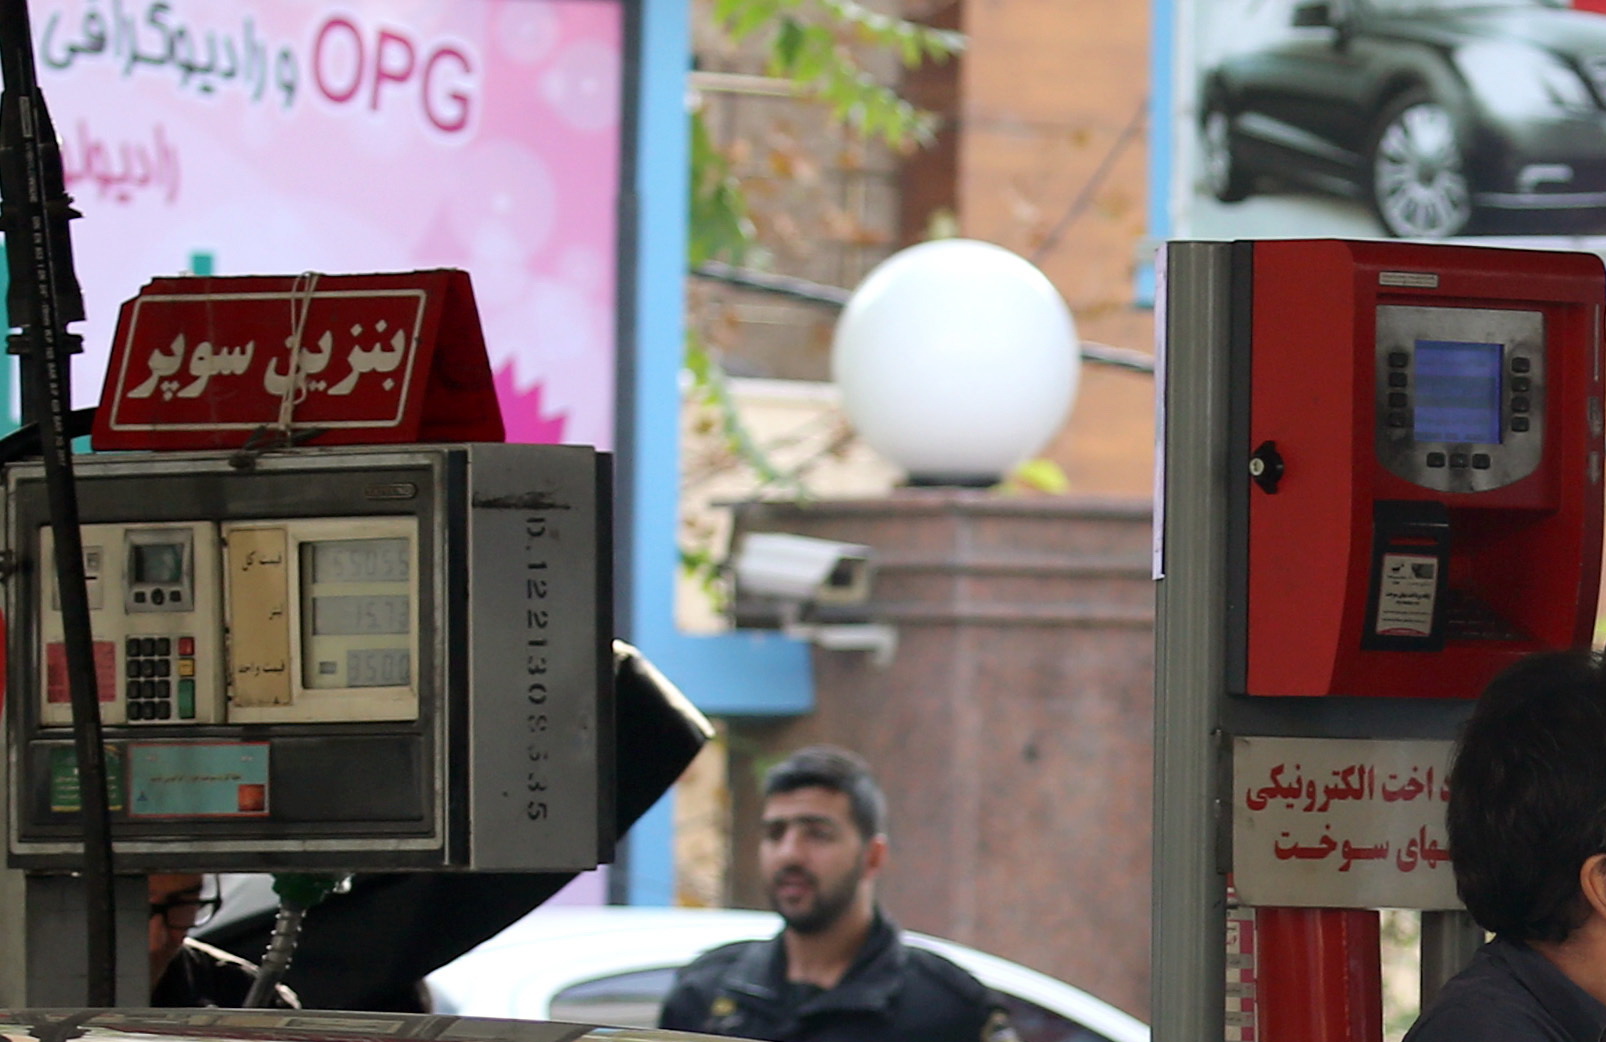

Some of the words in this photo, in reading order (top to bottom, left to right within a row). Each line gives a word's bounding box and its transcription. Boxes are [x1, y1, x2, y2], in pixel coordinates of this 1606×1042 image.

[275, 46, 300, 105] و
[312, 17, 473, 133] OPG
[127, 330, 256, 401] سوپر
[263, 318, 406, 398] بنزین
[1246, 763, 1376, 812] الکترونیکی
[1274, 823, 1389, 872] سوخت
[1396, 824, 1450, 873] های
